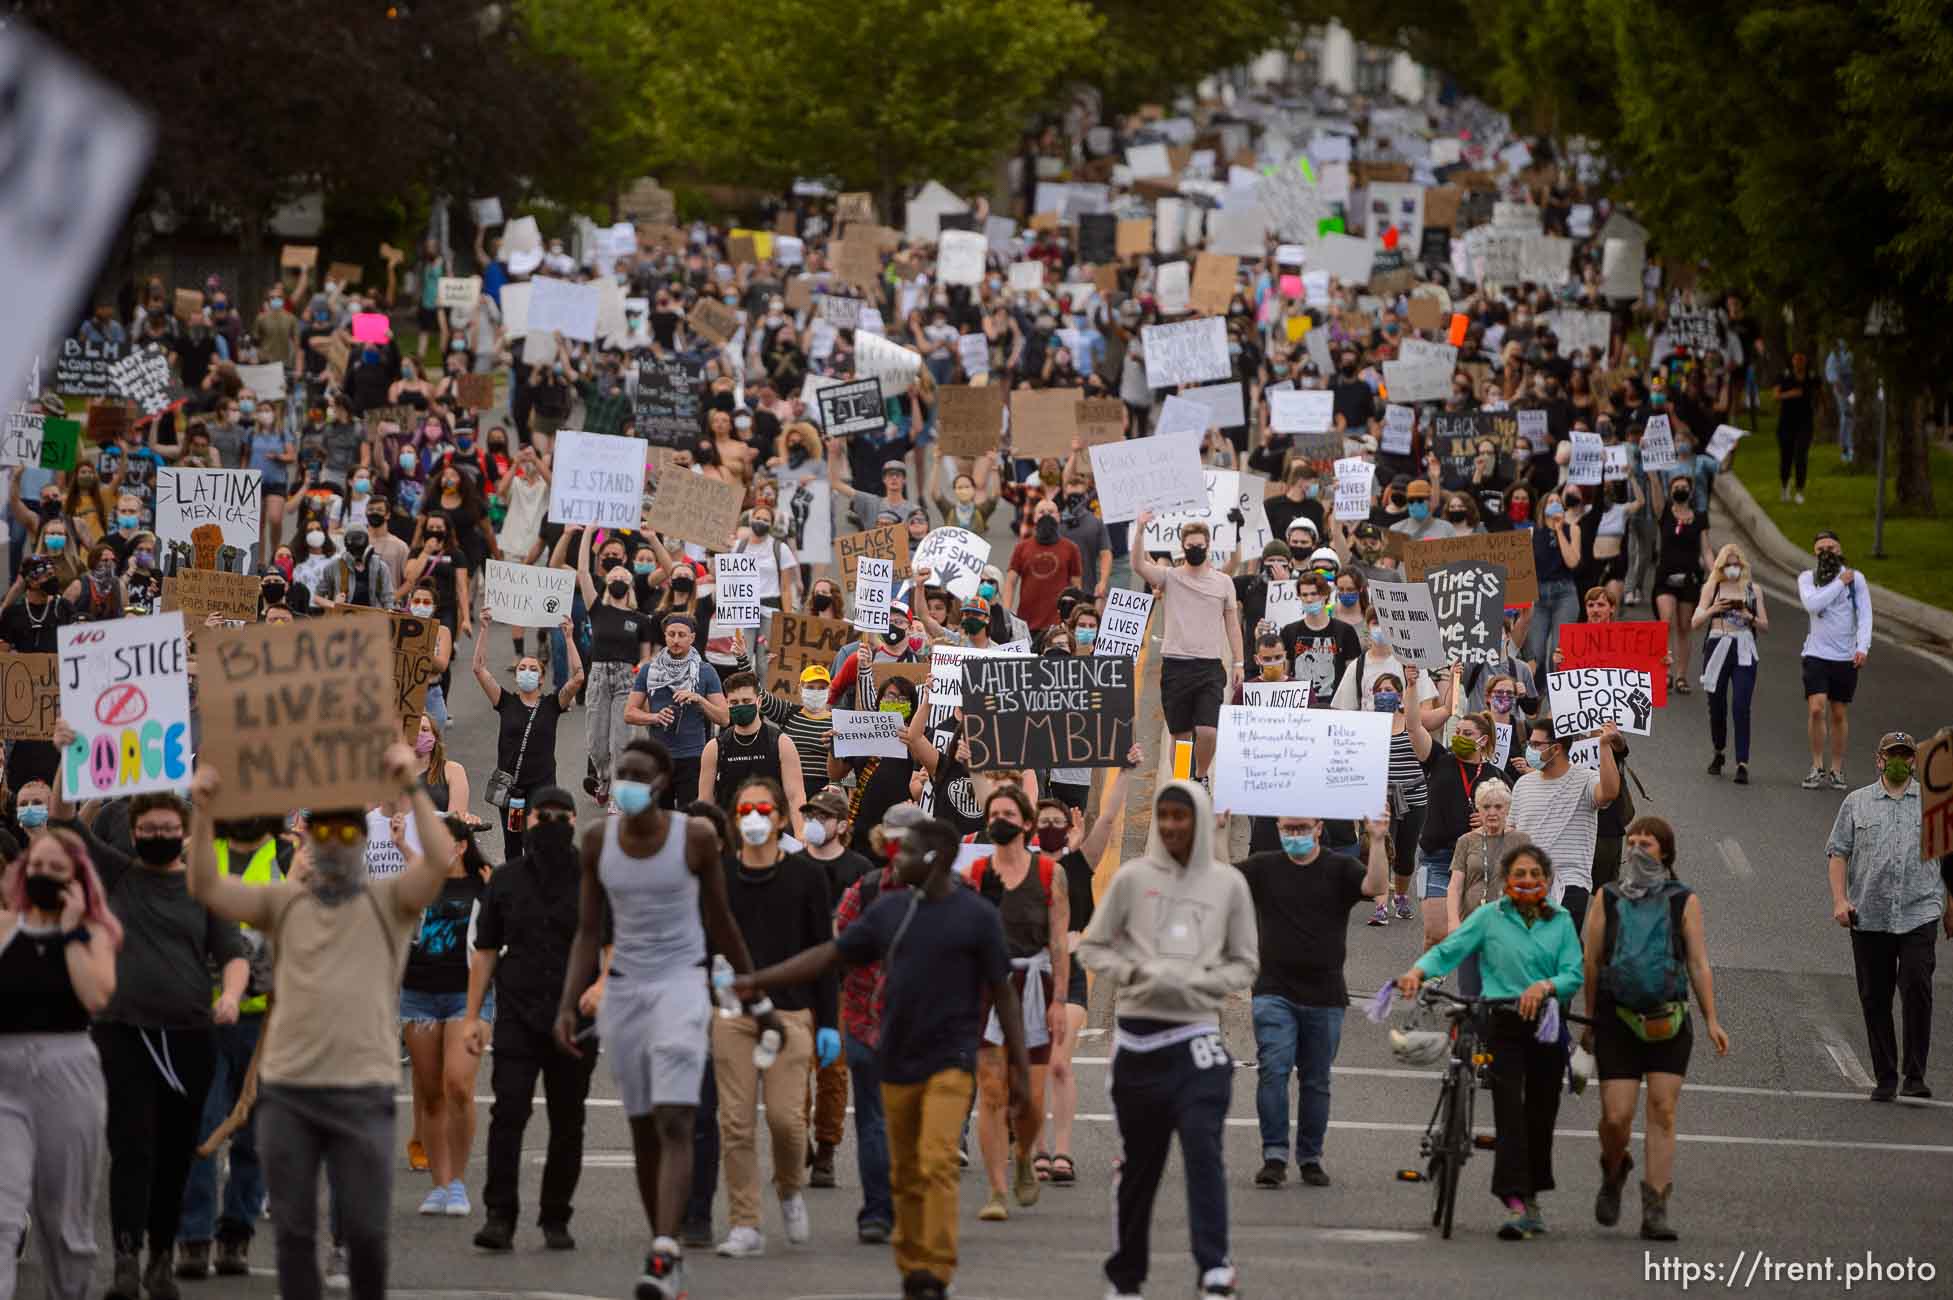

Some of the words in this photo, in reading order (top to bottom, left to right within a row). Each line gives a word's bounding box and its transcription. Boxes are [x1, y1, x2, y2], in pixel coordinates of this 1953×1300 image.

[175, 472, 262, 508] LATINX
[586, 471, 635, 494] STAND
[1341, 482, 1367, 495] LIVES
[180, 503, 247, 523] MEXICA
[560, 498, 606, 522] WITH
[607, 501, 636, 523] YOU
[841, 527, 895, 556] BLACK
[1145, 523, 1225, 544] Matr
[720, 558, 757, 572] BLACK
[860, 561, 889, 578] BLACK
[948, 546, 986, 575] SHOOT
[489, 564, 529, 586] BLACK
[723, 583, 753, 598] LIVES
[1375, 588, 1385, 600] THE
[1390, 590, 1409, 602] SYSTEM
[1112, 592, 1149, 612] BLACK
[1438, 590, 1483, 621] UP!
[717, 605, 760, 620] MATTER
[854, 608, 889, 626] MATTER
[1378, 607, 1389, 618] WAS
[1391, 609, 1406, 621] NEVER
[1108, 617, 1139, 636] LIVES
[1400, 629, 1411, 641] WAS
[1470, 621, 1489, 644] 4
[69, 631, 105, 646] NO
[1096, 637, 1140, 657] MATTER
[217, 627, 379, 682] BLACK
[962, 660, 1034, 695] WHITE
[1040, 659, 1128, 690] SILENCE
[1549, 668, 1651, 692] JUSTICE
[232, 674, 382, 730] LIVES
[995, 691, 1020, 713] IS
[1021, 689, 1090, 712] VIOLENCE
[1244, 691, 1261, 707] NO
[1266, 689, 1309, 709] JUSTICE
[1578, 688, 1629, 709] FOR
[849, 715, 894, 725] JUSTICE
[1555, 708, 1624, 735] GEORGE
